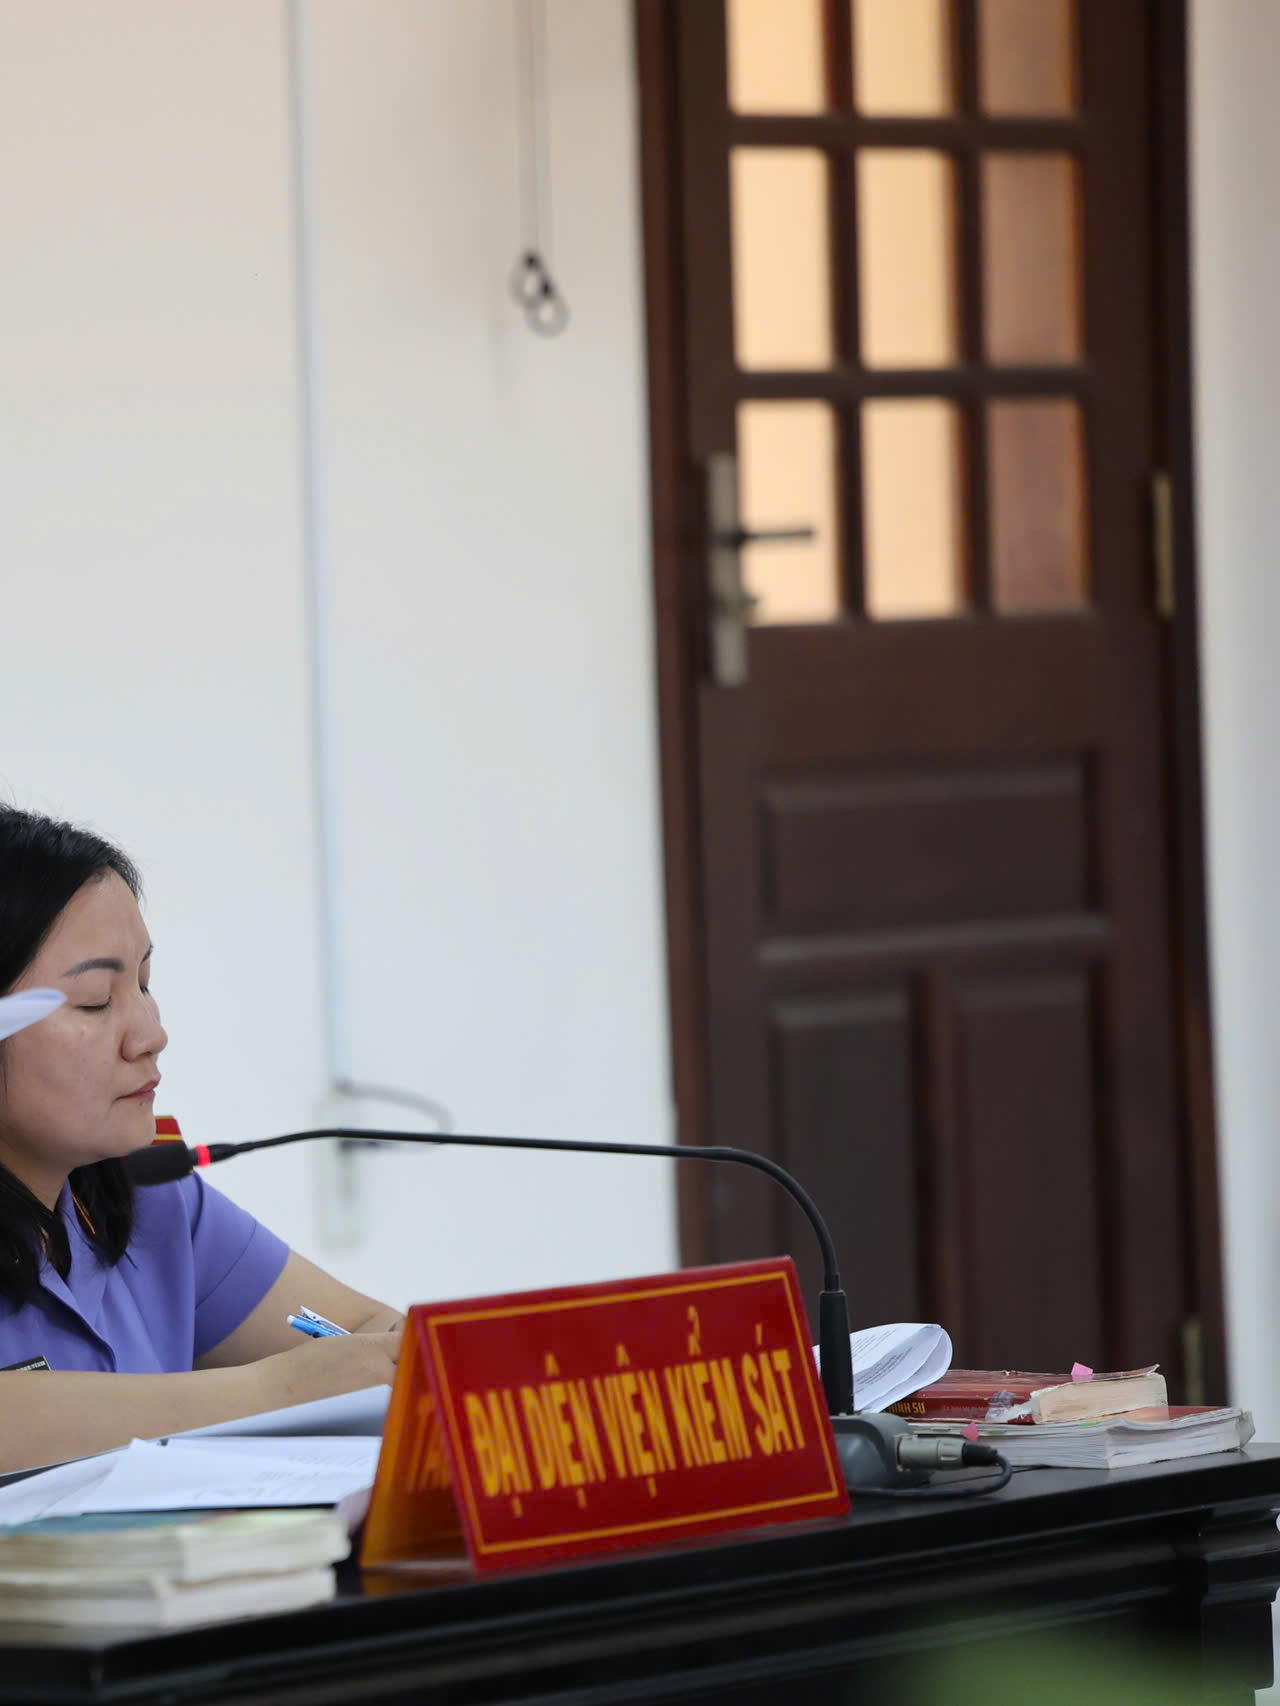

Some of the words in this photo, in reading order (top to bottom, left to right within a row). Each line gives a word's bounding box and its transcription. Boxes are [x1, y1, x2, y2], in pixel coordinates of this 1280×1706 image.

[464, 1387, 532, 1517] ĐẠI
[520, 1353, 606, 1508] DIỆN
[594, 1344, 675, 1497] VIỆN
[665, 1305, 751, 1468] KIỂM
[741, 1323, 805, 1458] SÁT
